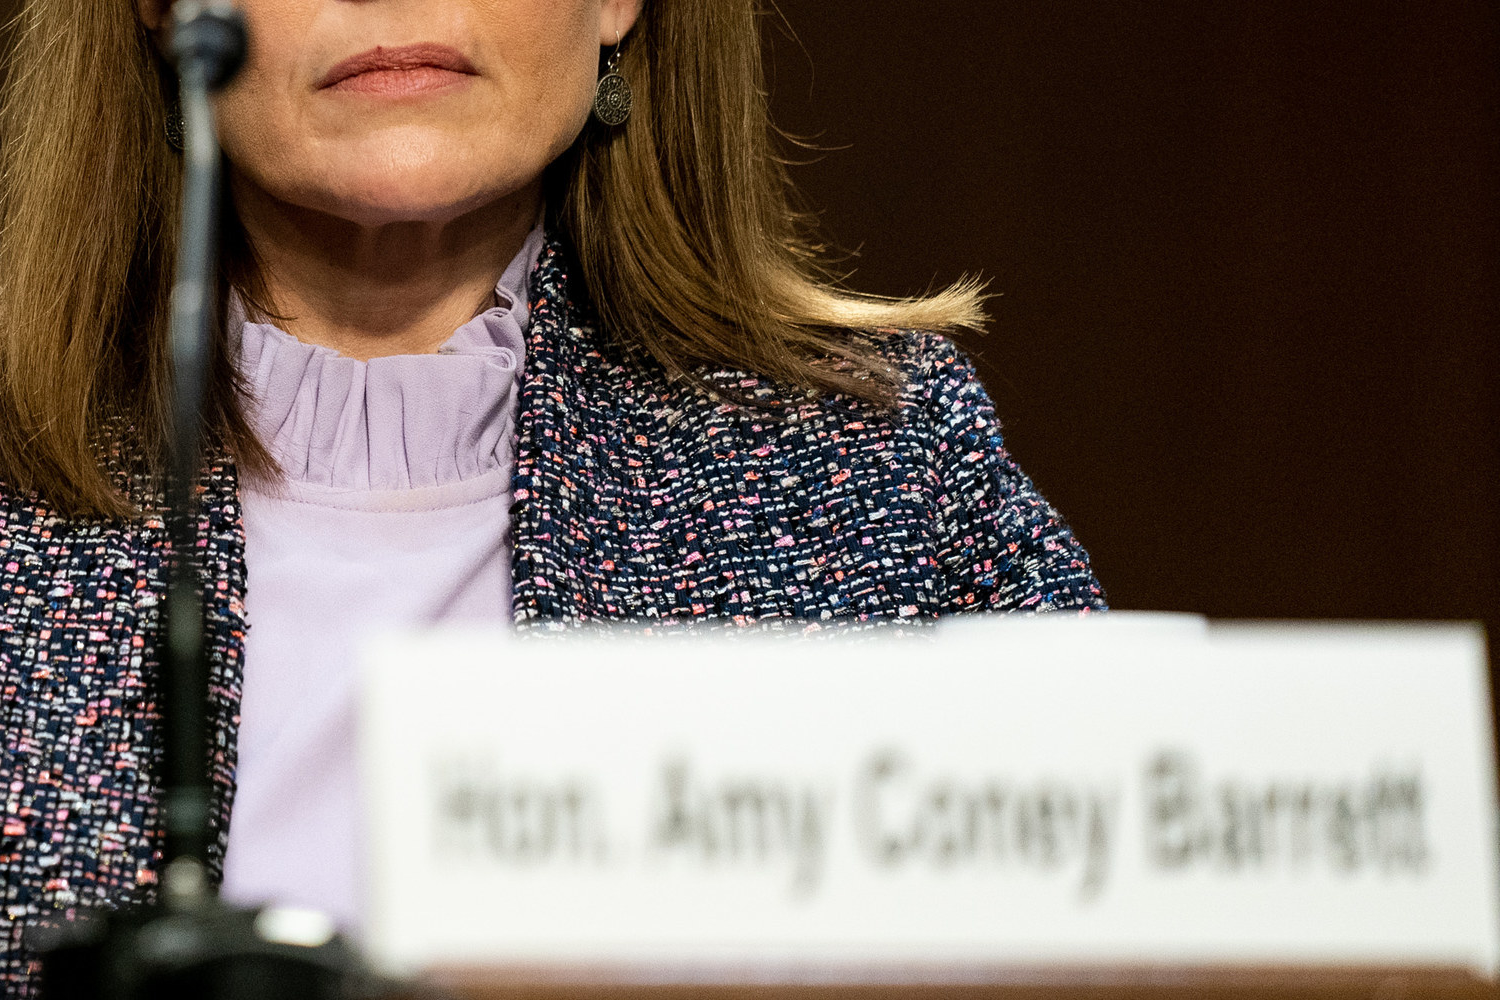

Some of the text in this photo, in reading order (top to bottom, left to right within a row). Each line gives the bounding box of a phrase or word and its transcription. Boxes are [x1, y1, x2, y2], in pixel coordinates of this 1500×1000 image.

[432, 743, 1435, 904] Hon. Amy Coney Barrett
